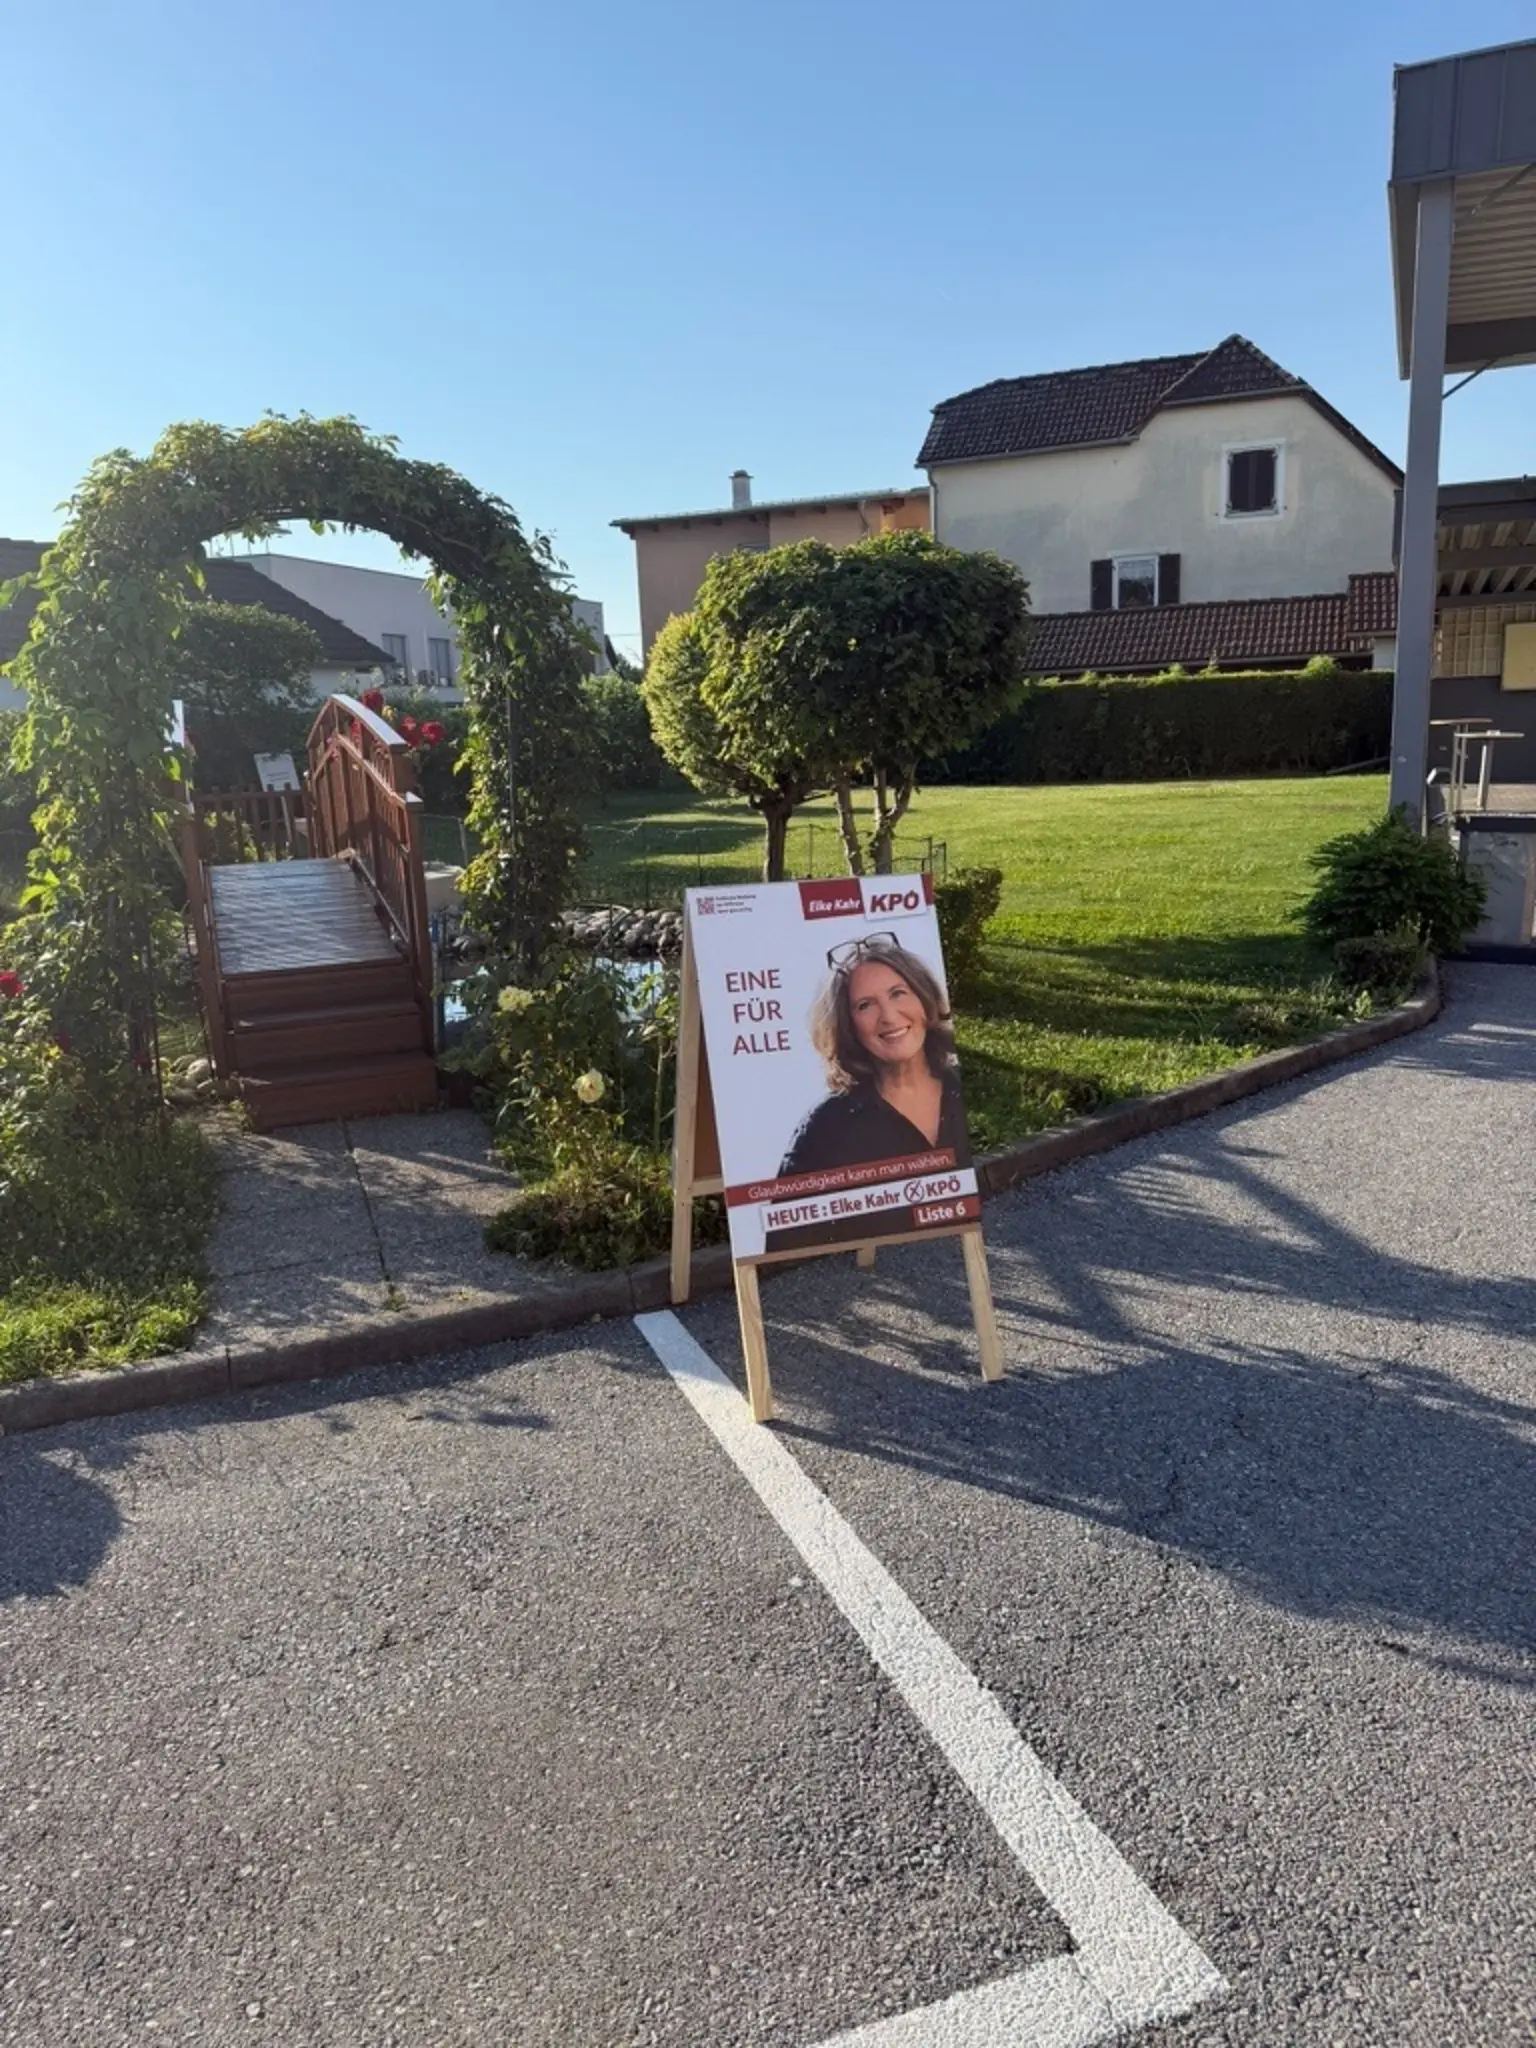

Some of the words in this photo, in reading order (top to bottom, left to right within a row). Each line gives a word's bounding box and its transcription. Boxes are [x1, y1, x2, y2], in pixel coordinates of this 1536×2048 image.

[809, 899, 832, 912] Elke
[834, 897, 861, 910] Kahr
[871, 889, 919, 913] KPÖ
[725, 968, 782, 993] EINE
[732, 997, 783, 1024] FÜR
[732, 1030, 791, 1056] ALLE
[748, 1173, 846, 1200] Glaubwürdigkeit
[848, 1167, 877, 1182] kann
[879, 1162, 905, 1175] man
[907, 1154, 952, 1171] wählen.
[767, 1203, 820, 1227] HEUTE
[829, 1197, 862, 1215] Elke
[865, 1190, 901, 1208] Kahr
[925, 1175, 961, 1197] KPÖ
[918, 1205, 954, 1223] Liste
[956, 1201, 967, 1216] 6
